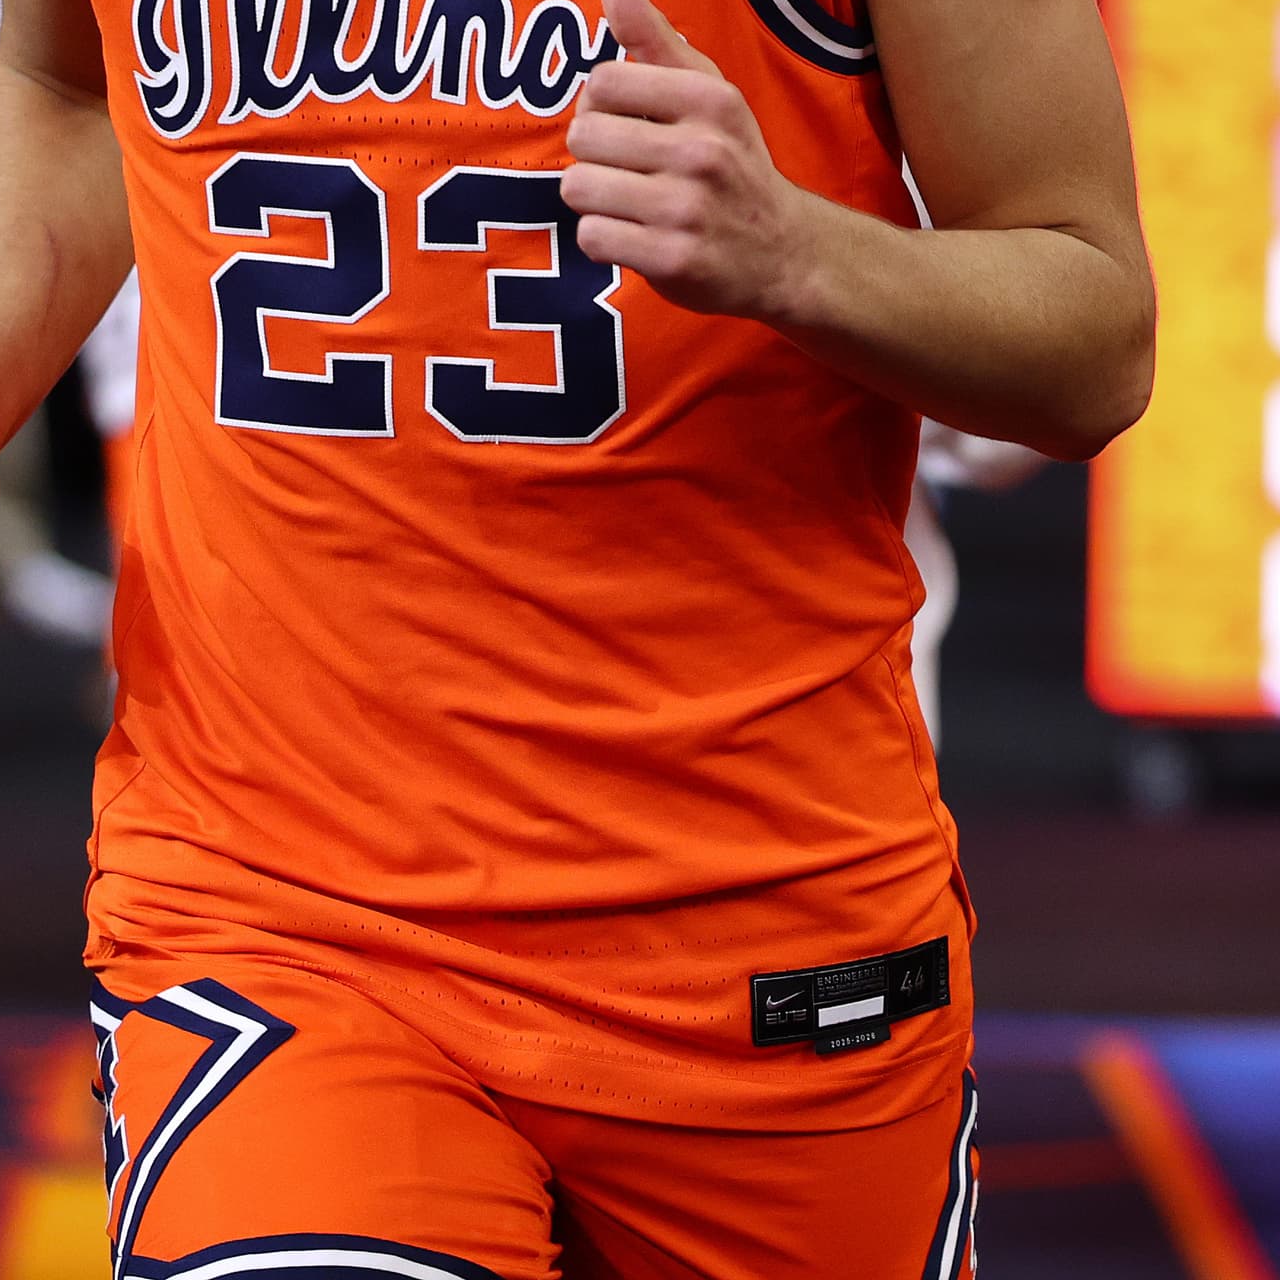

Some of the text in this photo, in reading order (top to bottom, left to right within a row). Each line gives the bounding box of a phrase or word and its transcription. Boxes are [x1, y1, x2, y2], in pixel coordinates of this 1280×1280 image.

[205, 151, 627, 444] 23
[817, 966, 885, 986] ENGINEERED
[830, 1031, 876, 1049] 2025-2026
